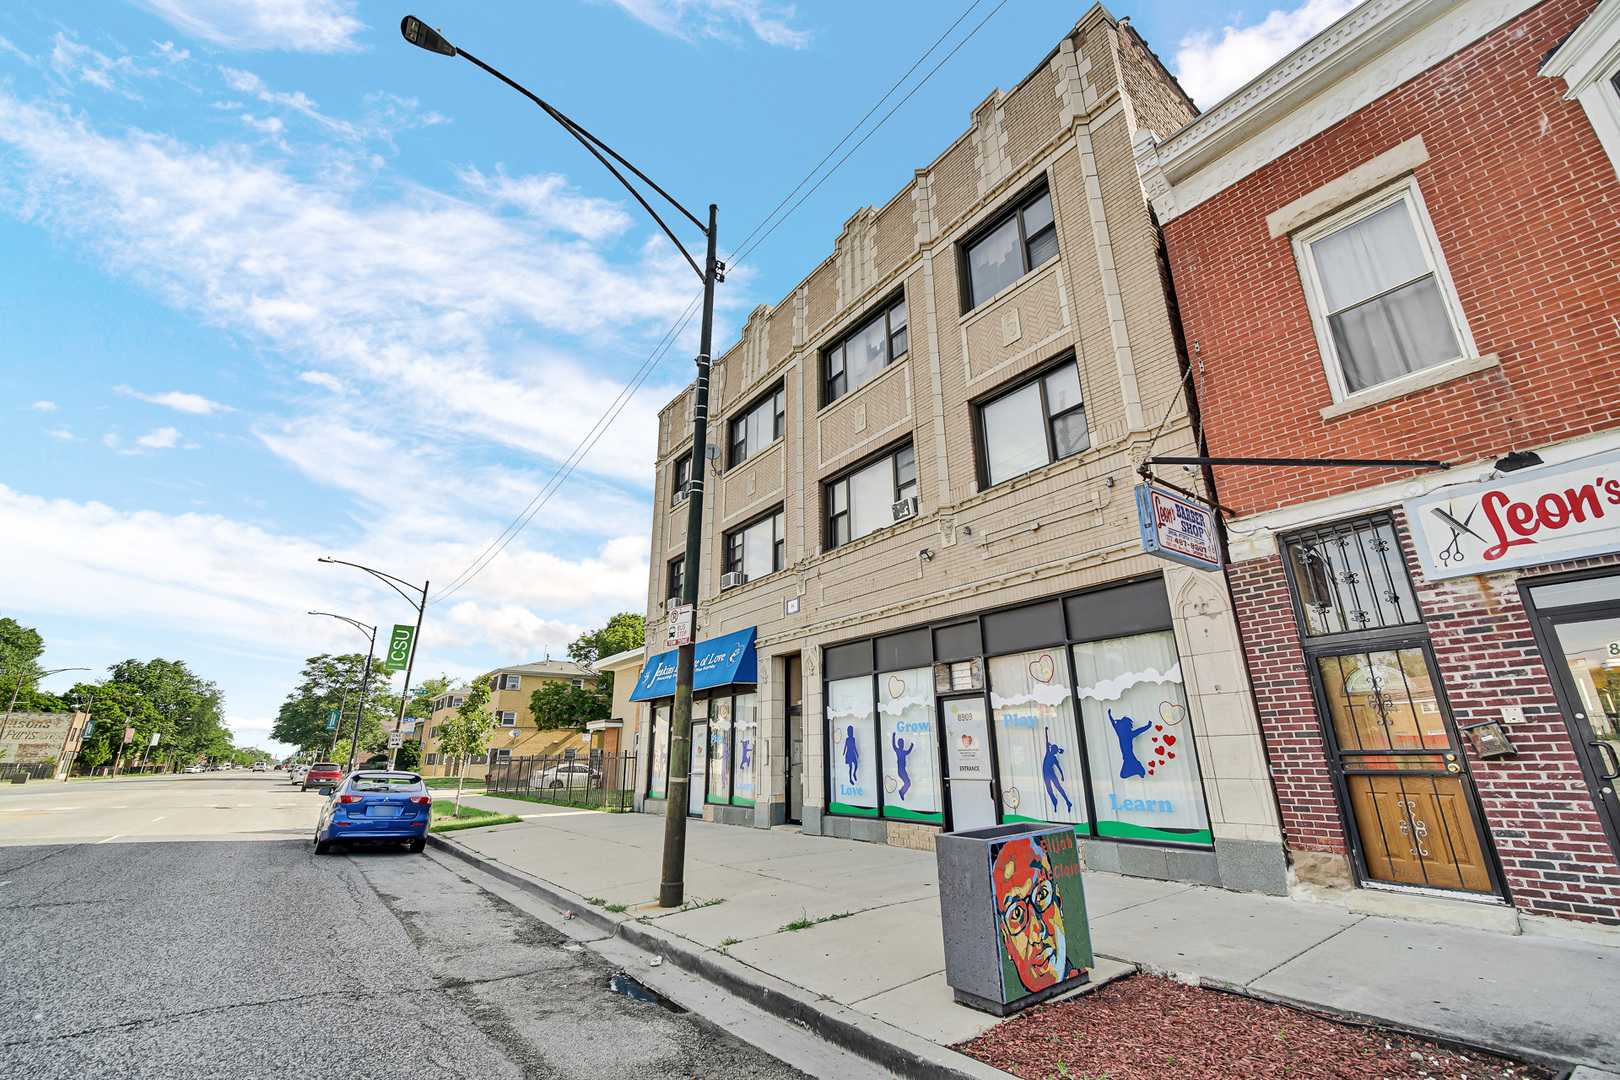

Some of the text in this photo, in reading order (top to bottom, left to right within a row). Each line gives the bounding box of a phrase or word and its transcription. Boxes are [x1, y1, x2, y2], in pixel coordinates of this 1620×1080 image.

[1155, 496, 1205, 528] Leon's BARBER
[1482, 477, 1620, 561] Leon's
[1180, 520, 1205, 538] SHOP
[391, 629, 410, 662] CSU
[708, 652, 726, 664] Love
[957, 713, 973, 721] 8909
[1002, 713, 1037, 729] Play
[896, 720, 930, 733] Grow
[840, 784, 863, 796] Love
[1109, 793, 1174, 813] Learn
[1041, 835, 1073, 853] Elijah
[1037, 861, 1080, 883] McClain
